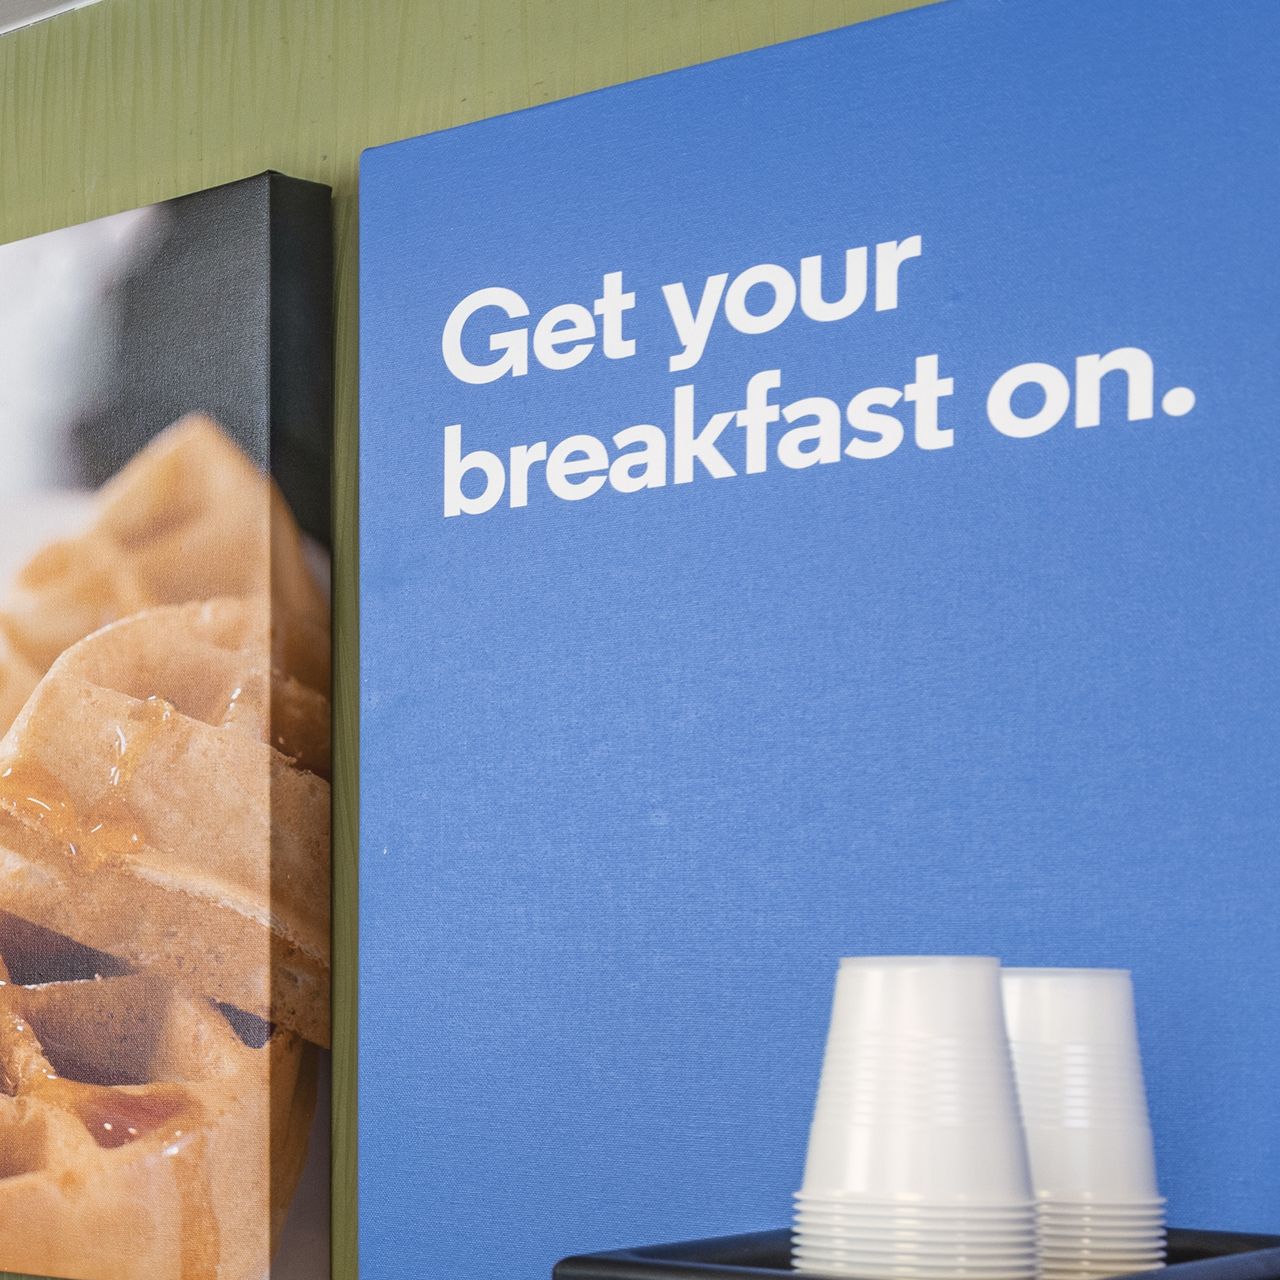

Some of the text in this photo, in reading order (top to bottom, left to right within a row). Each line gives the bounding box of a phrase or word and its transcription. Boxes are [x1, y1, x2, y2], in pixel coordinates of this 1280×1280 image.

[442, 235, 922, 384] Get your
[443, 347, 1197, 518] breakfast on.
